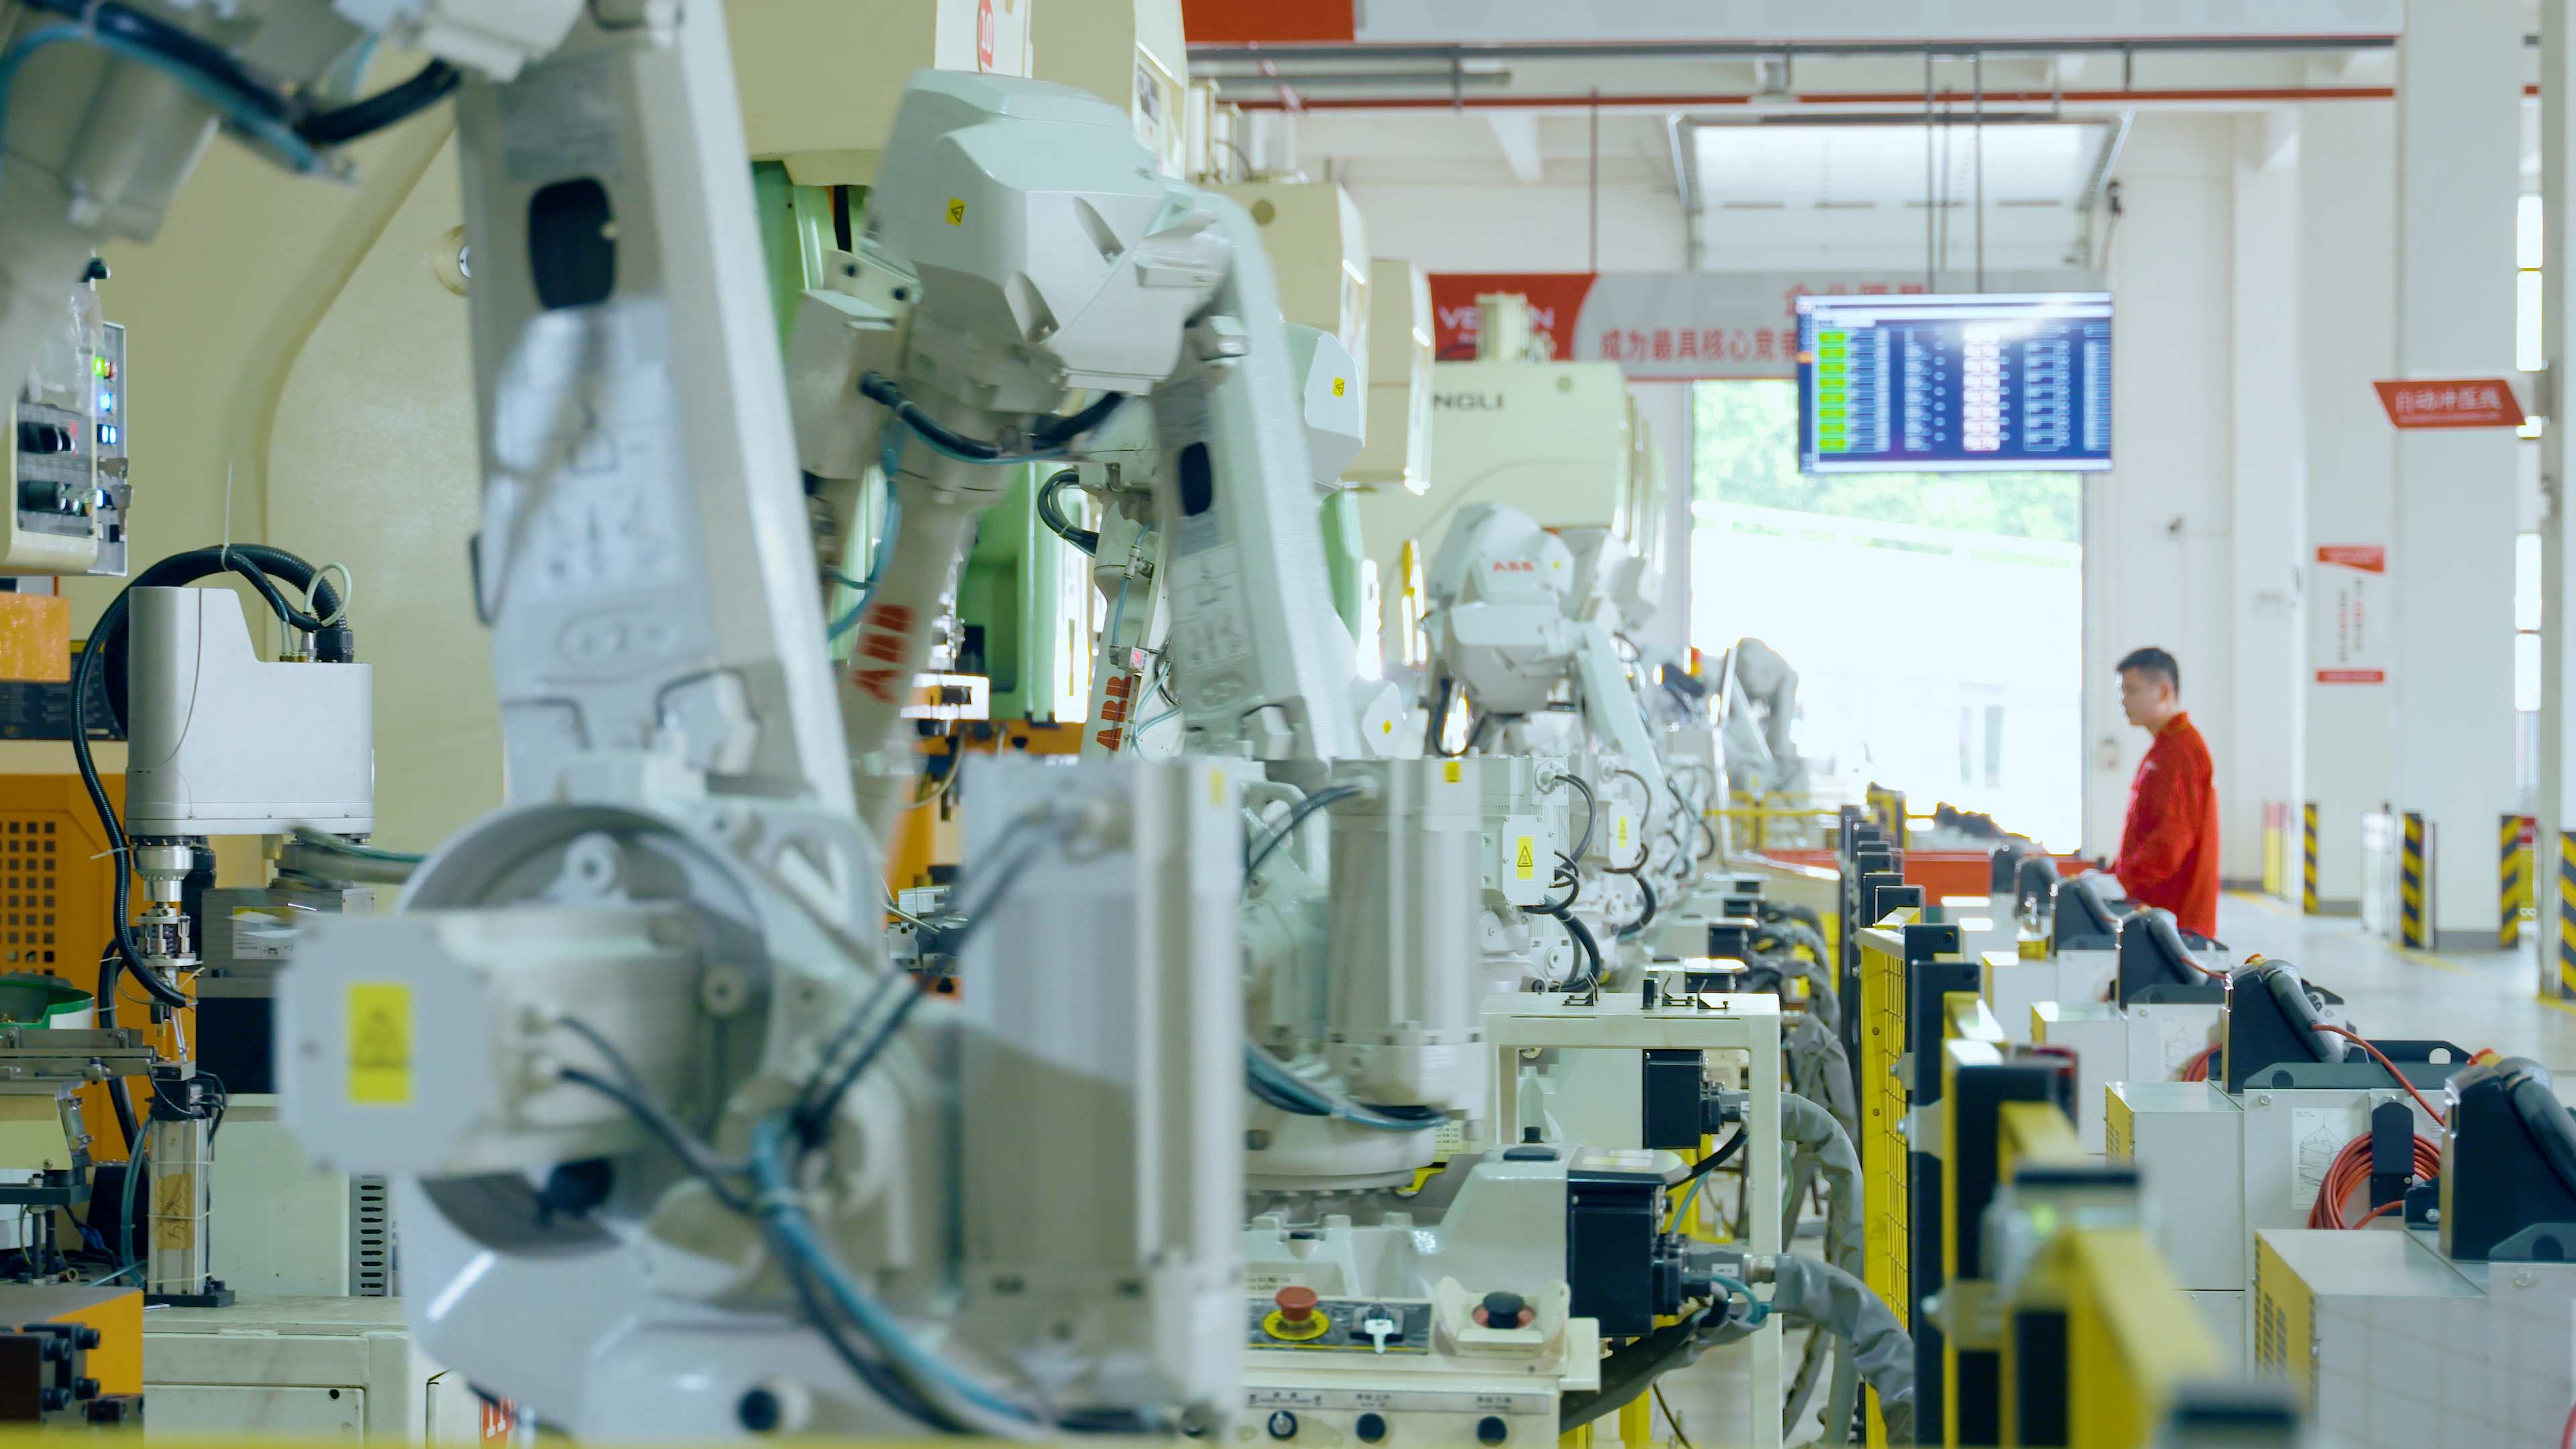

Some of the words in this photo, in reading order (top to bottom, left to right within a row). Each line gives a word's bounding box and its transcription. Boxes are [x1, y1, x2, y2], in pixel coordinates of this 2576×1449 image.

[981, 9, 992, 54] 10
[2396, 386, 2503, 413] 自动冲压线
[1493, 561, 1534, 572] ABB
[1096, 676, 1132, 752] ABB
